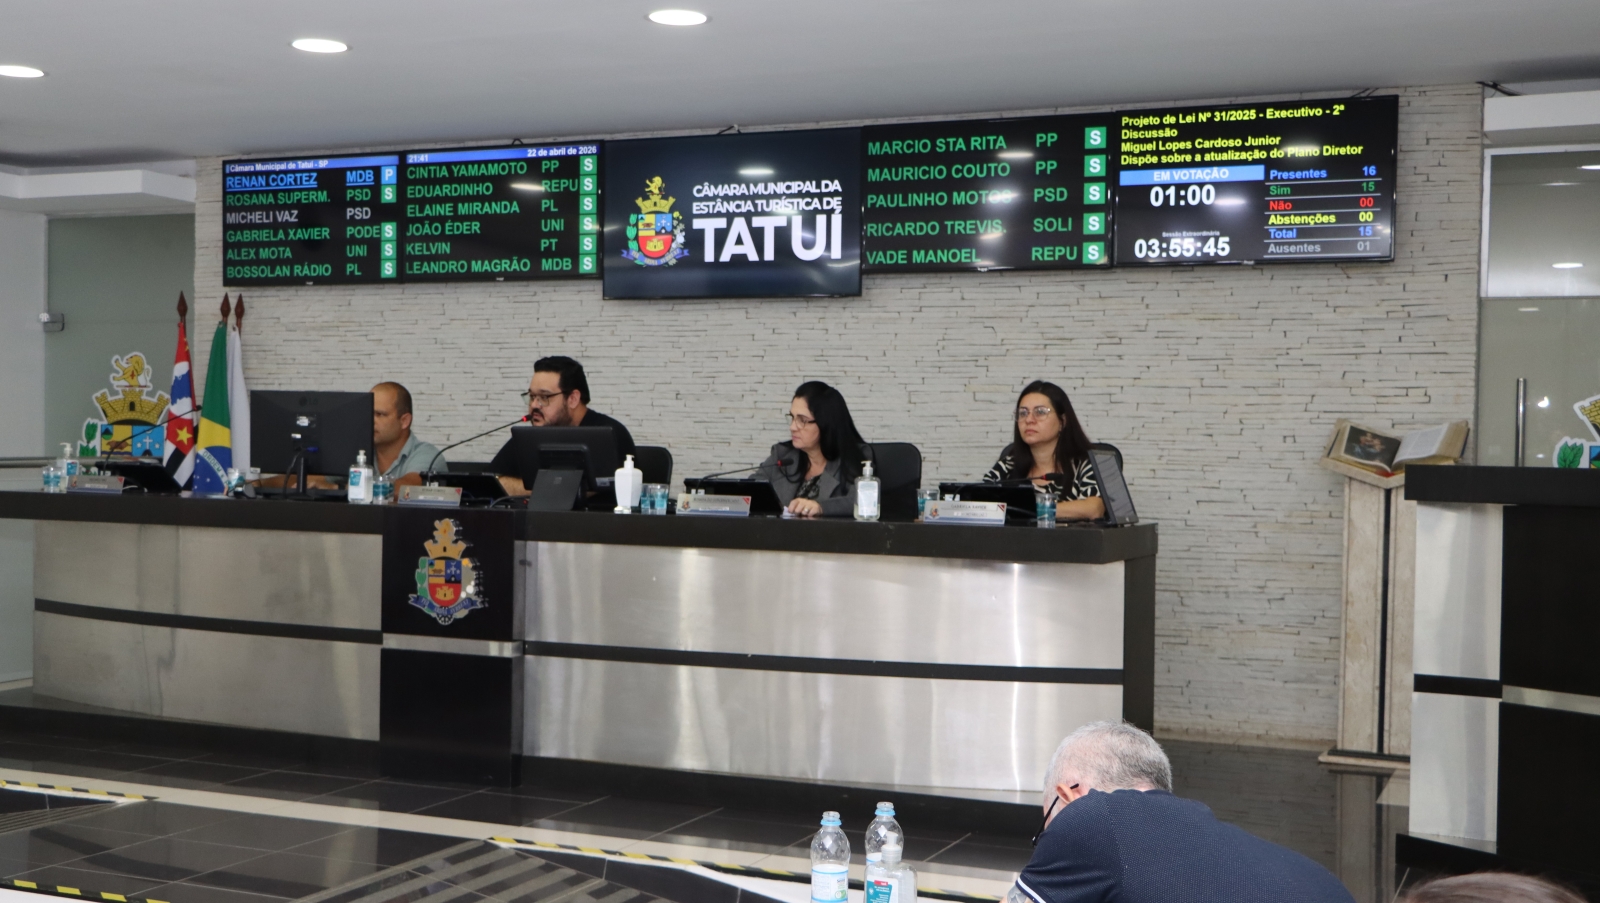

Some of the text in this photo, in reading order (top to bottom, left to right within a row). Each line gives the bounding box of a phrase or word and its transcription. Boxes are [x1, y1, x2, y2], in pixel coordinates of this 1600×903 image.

[1122, 116, 1160, 128] Projeto
[1163, 114, 1176, 125] de
[1179, 113, 1196, 124] Lei
[1198, 112, 1211, 122] Nº
[1214, 110, 1256, 121] 31/2025
[1266, 106, 1322, 119] Executivo
[1333, 105, 1344, 115] 2ª
[1122, 128, 1177, 139] Discussão
[868, 130, 1100, 155] MARCIO STA RITA PP S
[1121, 136, 1280, 152] Miguel Lopes Cardoso Junior
[1121, 155, 1158, 166] Dispõe
[1161, 153, 1192, 163] sobre
[1205, 150, 1267, 161] atualização
[1270, 148, 1284, 158] do
[1287, 147, 1319, 157] Plano
[1323, 145, 1362, 156] Diretor
[256, 162, 286, 171] Municipal
[407, 158, 592, 179] CINTIA YAMAMOTO PP S
[868, 158, 1100, 182] MAURICIO COUTO PP S
[1154, 167, 1228, 181] EM VOTAÇÃO
[1270, 166, 1376, 180] Presentes 16
[227, 169, 393, 188] RENAN CORTEZ MDB P
[408, 178, 592, 198] EDUARDINHO REPU S
[693, 180, 841, 197] CÂMARA MUNICIPAL DA
[1150, 184, 1215, 207] 01:00
[1270, 182, 1374, 195] Sim 15
[227, 188, 392, 206] ROSANA SUPERM. PSD S
[693, 196, 841, 214] ESTÂNCIA TURÍSTICA DE
[868, 186, 1100, 208] PAULINHO MOTOS PSD S
[1270, 198, 1373, 210] Não 00
[227, 208, 371, 224] MICHELI VAZ PSD
[408, 198, 592, 217] ELAINE MIRANDA PL S
[406, 218, 592, 236] JOÃO ÉDER UNI S
[867, 216, 1099, 236] RICARDO TREVIS. SOLI S
[1269, 212, 1373, 225] Abstenções 00
[227, 225, 392, 242] GABRIELA XAVIER PODE S
[693, 208, 842, 262] TATUÍ
[1269, 226, 1372, 239] Total 15
[227, 244, 392, 260] ALEX MOTA UNI S
[406, 238, 592, 255] KELVIN PT S
[867, 246, 1098, 264] VADE MANOEL REPU S
[1134, 237, 1230, 258] 03:55:45
[1268, 242, 1370, 254] Ausentes 01
[227, 262, 392, 278] BOSSOLAN RÁDIO PL S
[406, 257, 592, 274] LEANDRO MAGRÃO MDB S
